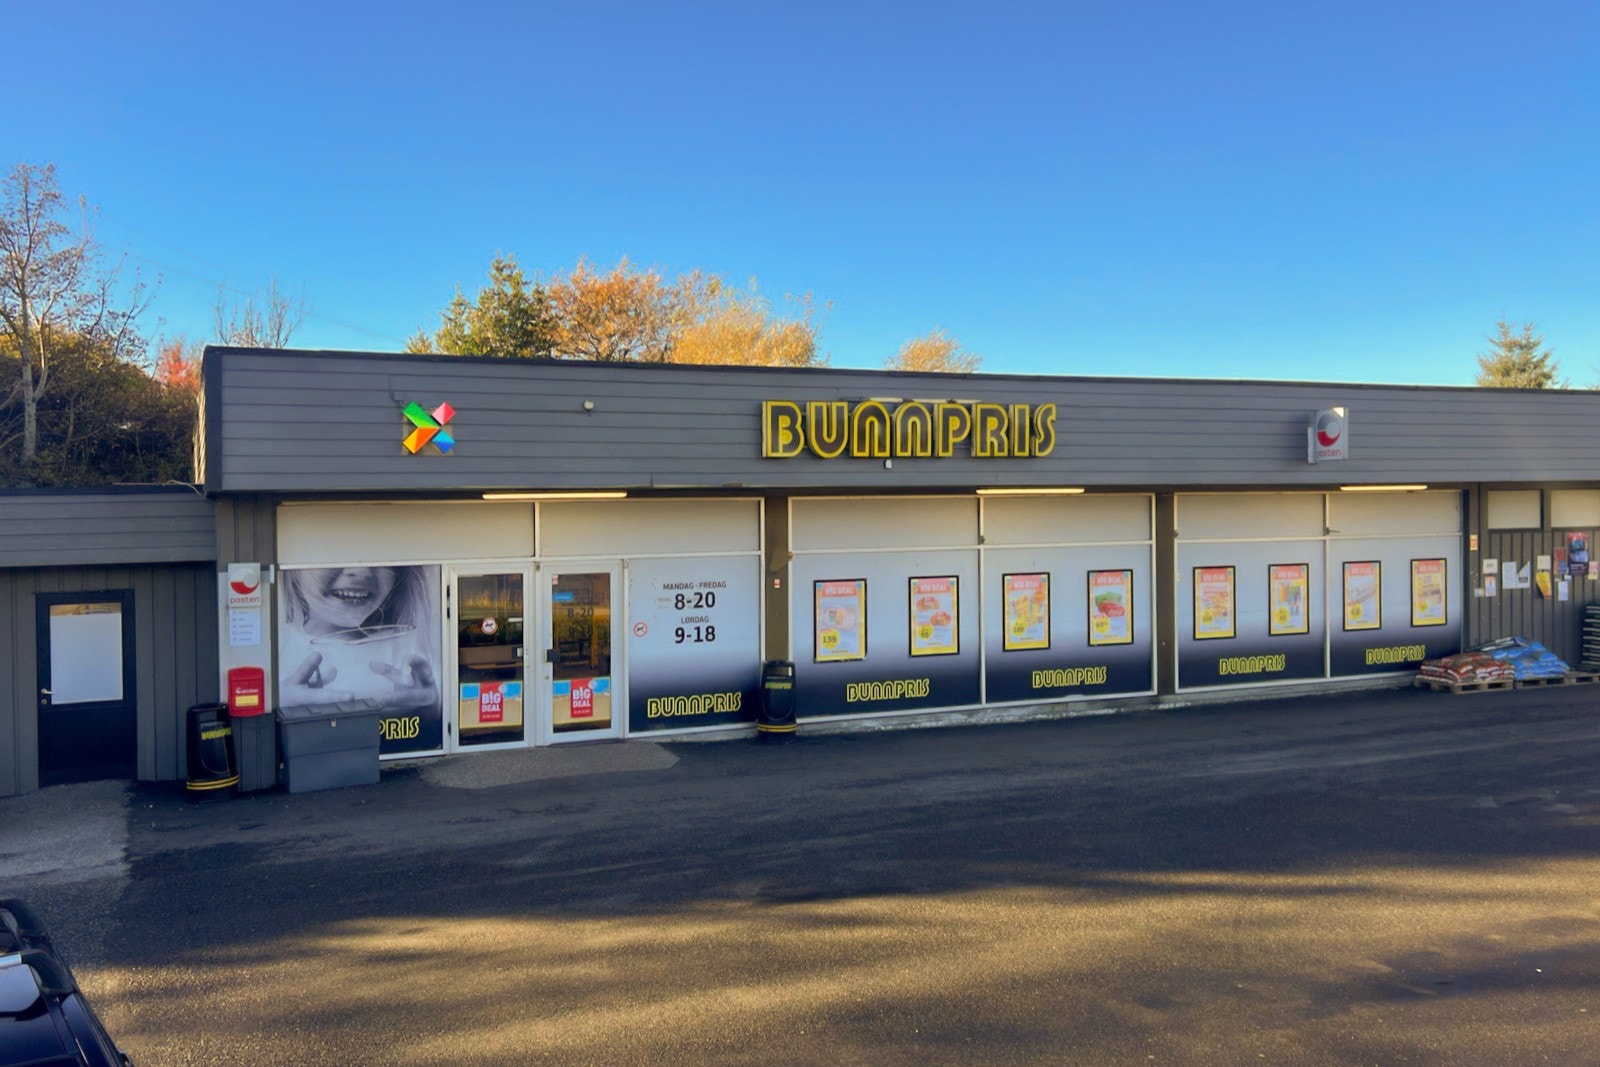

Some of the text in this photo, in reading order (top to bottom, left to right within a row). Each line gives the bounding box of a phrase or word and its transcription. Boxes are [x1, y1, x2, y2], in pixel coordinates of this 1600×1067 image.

[761, 400, 1056, 458] BUNNPRIS
[662, 582, 694, 590] MANDAG
[699, 581, 727, 589] FREDAG
[230, 596, 260, 604] posten
[674, 591, 716, 611] 8-20
[680, 615, 710, 624] LØRDAG
[674, 625, 716, 644] 9-18
[1219, 654, 1286, 675] BUNNPRIS
[1365, 645, 1426, 665] BUNNPRIS
[1032, 666, 1107, 689] BUNNPRIS
[846, 678, 930, 702] BUNNPRIS
[647, 692, 742, 718] BUNNPRIS
